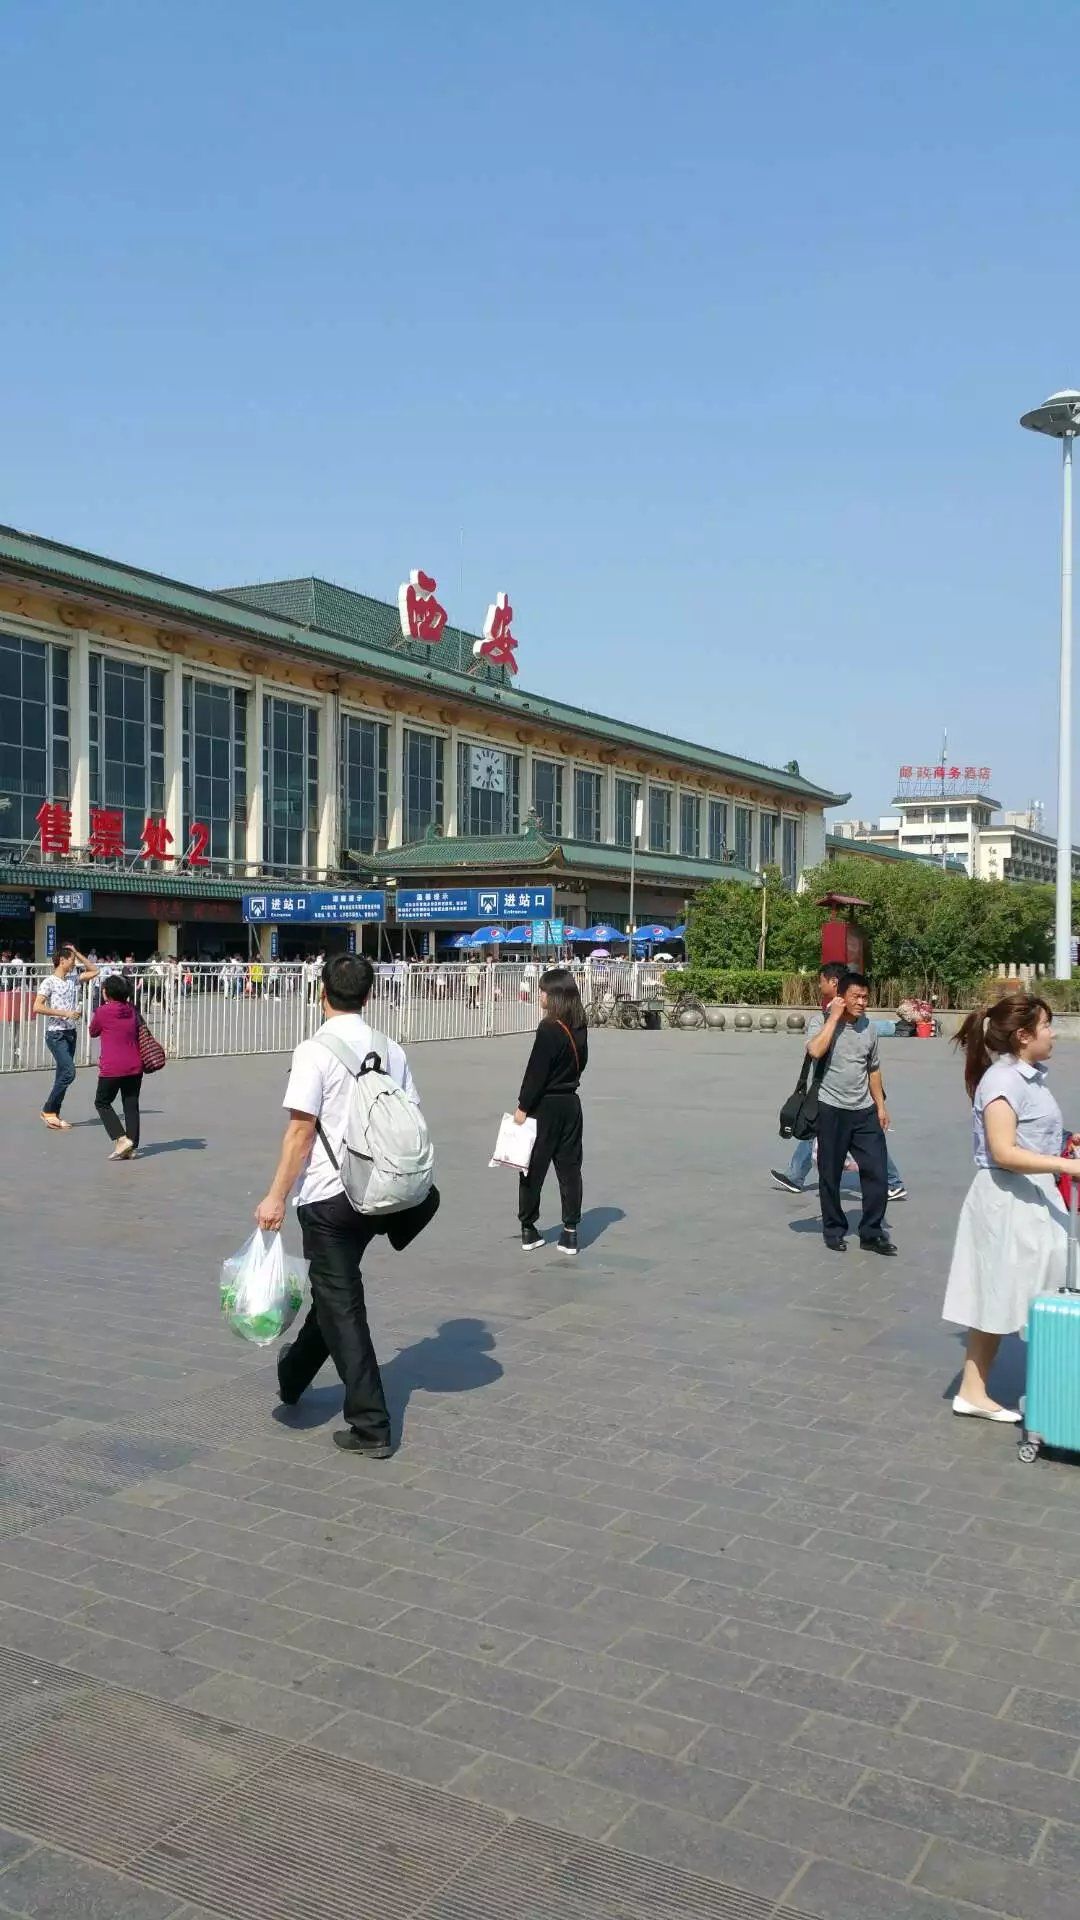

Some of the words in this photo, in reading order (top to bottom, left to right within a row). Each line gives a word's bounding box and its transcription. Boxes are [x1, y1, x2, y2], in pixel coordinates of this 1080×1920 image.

[900, 766, 991, 779] 邮政商务酒店
[271, 898, 306, 910] 进站口
[504, 893, 545, 907] 进站口
